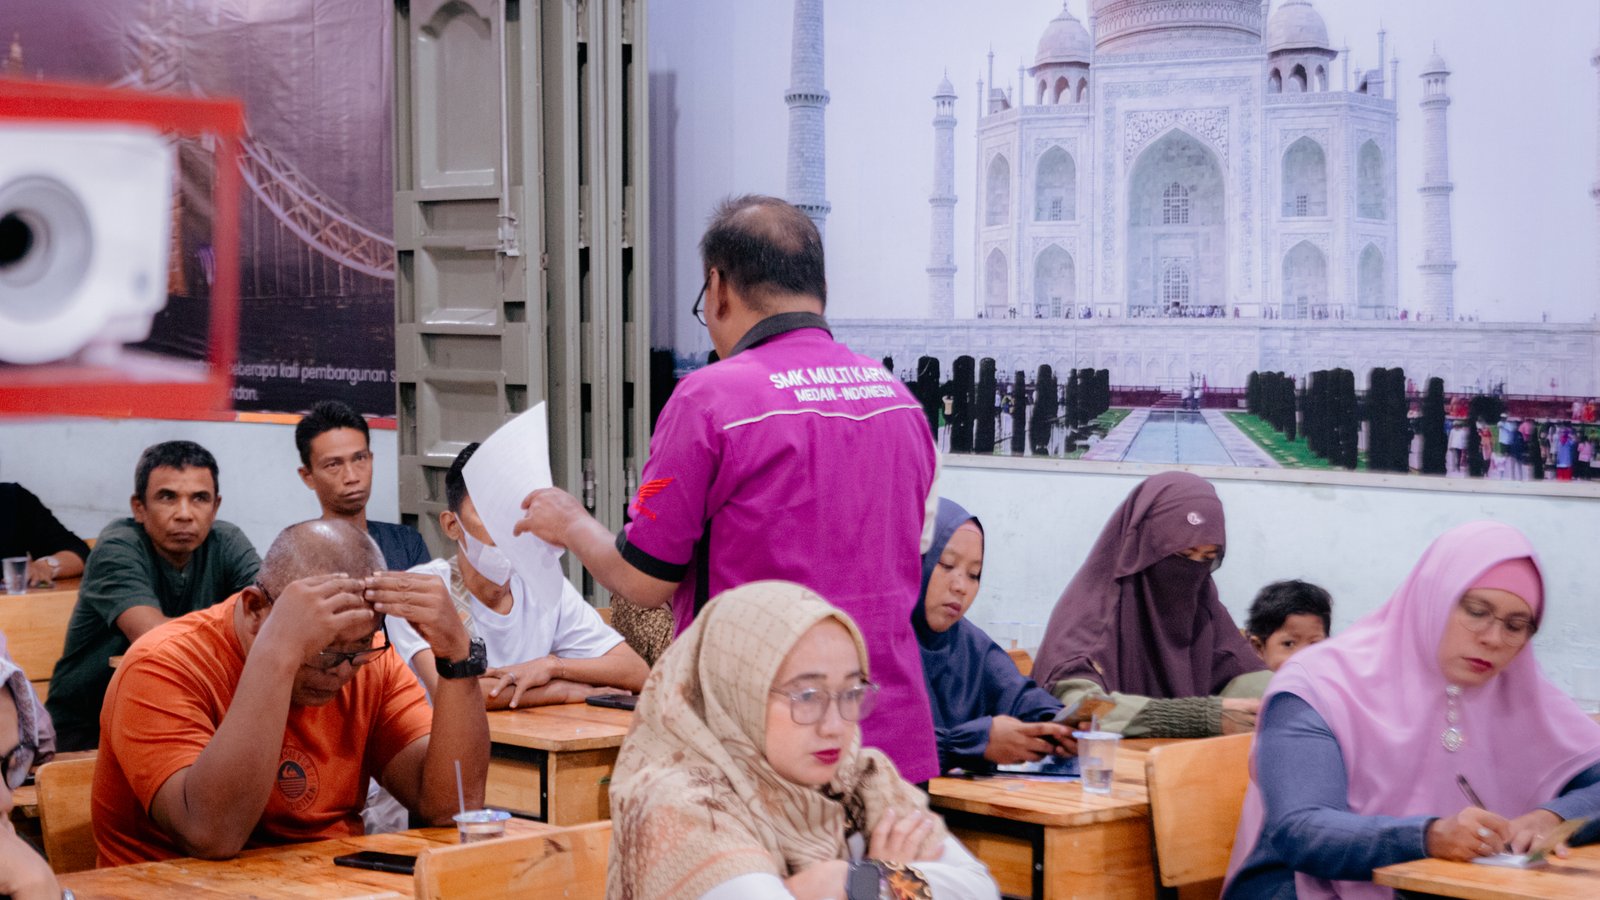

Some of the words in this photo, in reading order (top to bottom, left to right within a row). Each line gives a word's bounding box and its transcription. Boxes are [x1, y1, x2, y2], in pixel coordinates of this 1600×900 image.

[280, 362, 299, 379] kali
[301, 364, 387, 386] pembangunan
[769, 369, 811, 389] SMK
[806, 366, 851, 384] MULTI
[849, 366, 895, 383] KARYA
